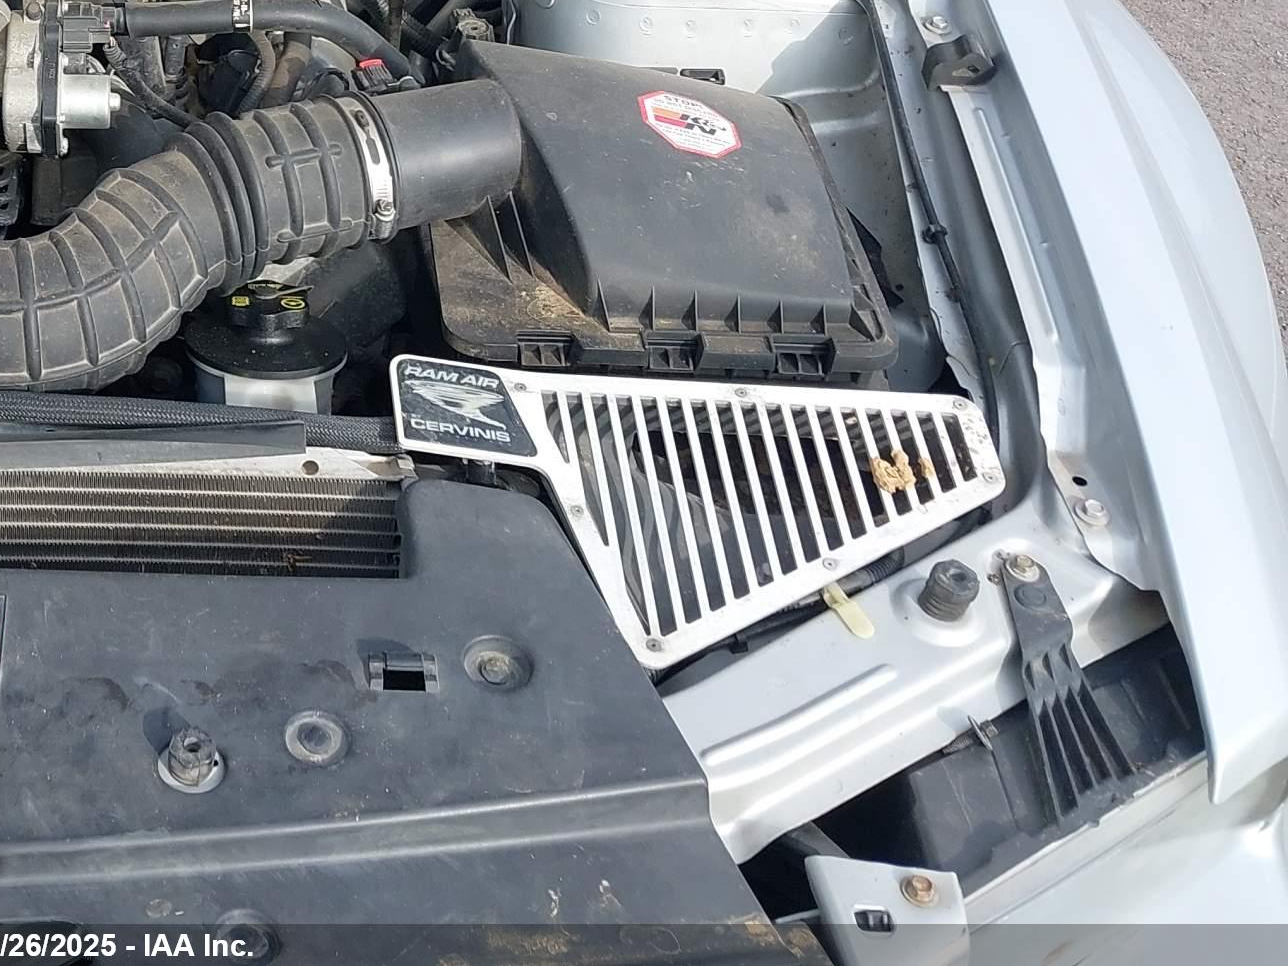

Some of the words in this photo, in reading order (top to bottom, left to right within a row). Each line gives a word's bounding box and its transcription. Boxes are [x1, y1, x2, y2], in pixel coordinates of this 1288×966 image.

[405, 365, 459, 382] RAM
[460, 374, 499, 389] AIR
[410, 418, 511, 443] CERVINIS
